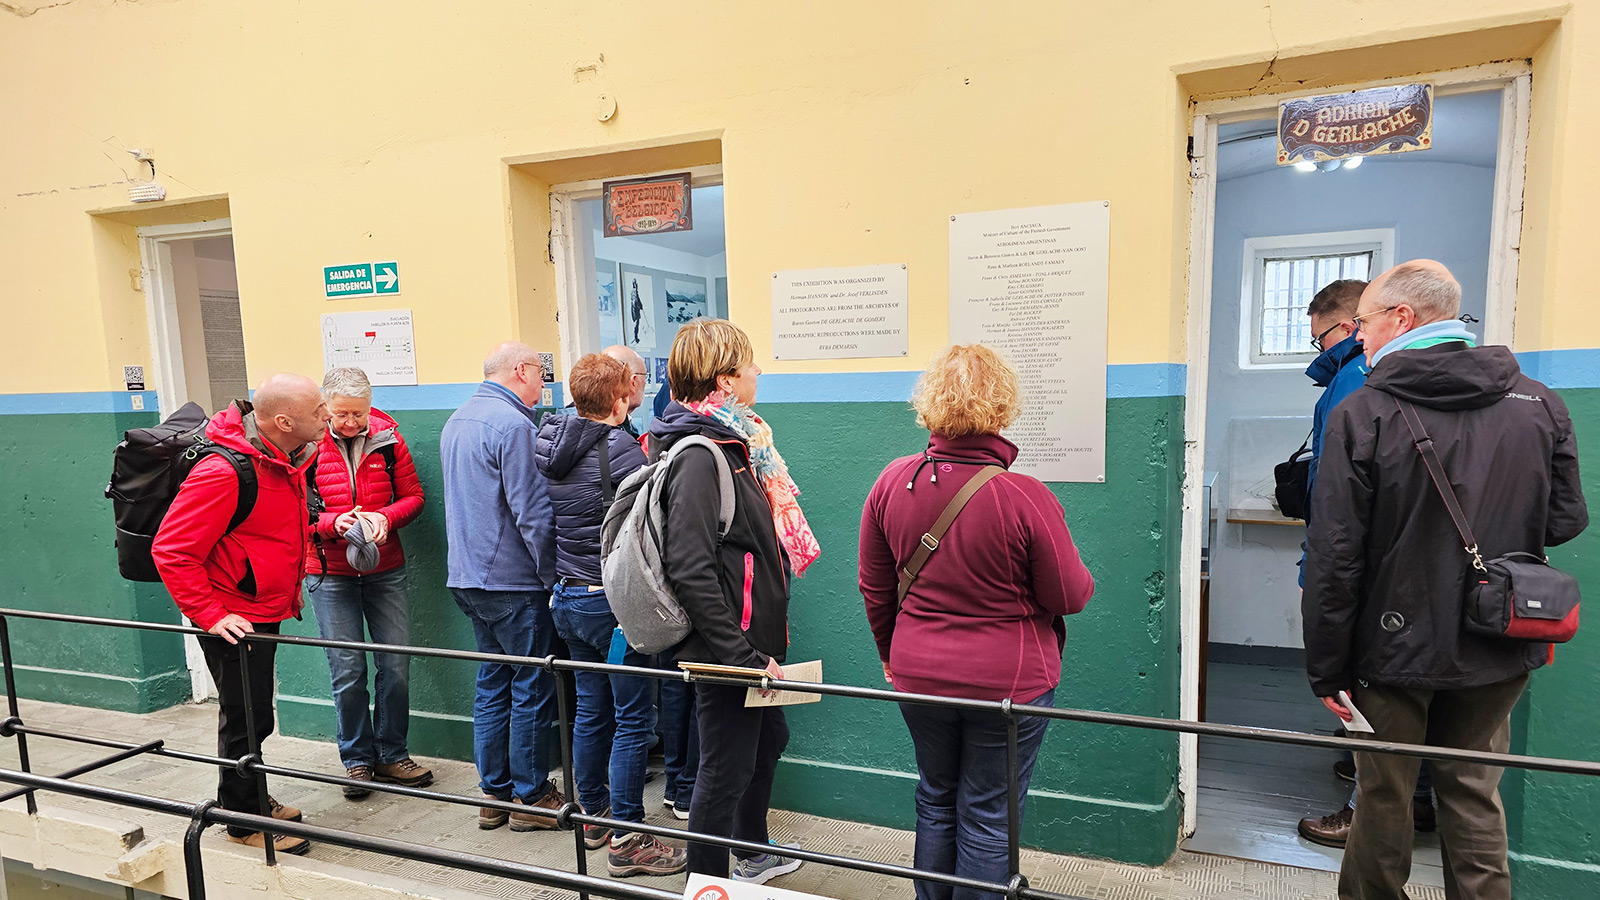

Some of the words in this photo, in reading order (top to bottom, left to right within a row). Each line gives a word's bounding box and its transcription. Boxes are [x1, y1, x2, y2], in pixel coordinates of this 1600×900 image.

[1315, 101, 1391, 125] ADRIAN
[1291, 118, 1310, 137] D
[1312, 106, 1417, 144] GERLACHE
[617, 185, 676, 207] EXPEDICION
[329, 270, 355, 280] SALIDA
[356, 268, 366, 278] DE
[327, 280, 372, 293] EMERGENCIA
[865, 302, 892, 310] ARCHIVES
[829, 317, 855, 325] GERLACHE
[817, 330, 860, 338] REPRODUCTIONS
